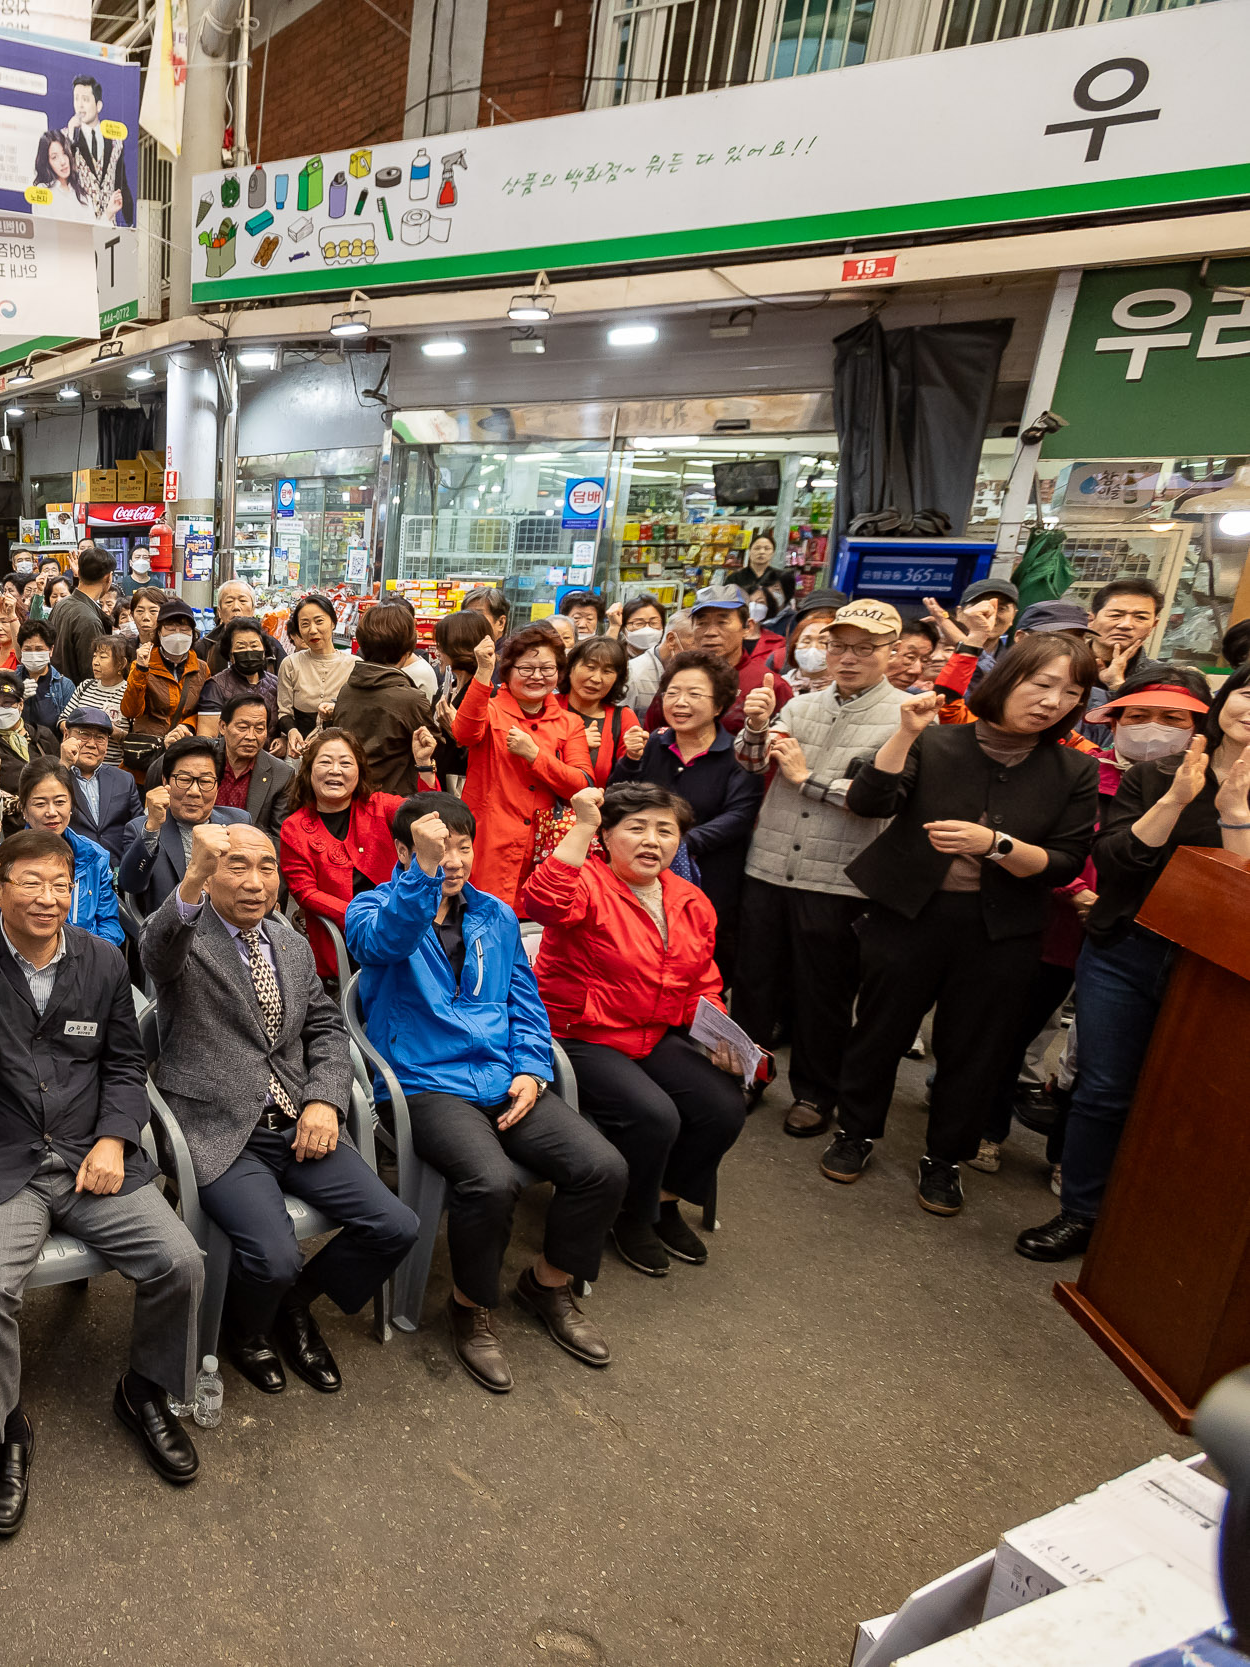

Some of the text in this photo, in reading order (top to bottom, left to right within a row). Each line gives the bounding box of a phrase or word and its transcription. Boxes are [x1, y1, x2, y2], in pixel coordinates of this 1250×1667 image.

[1044, 57, 1161, 162] 우
[503, 173, 557, 195] 상품의
[856, 260, 877, 275] 15
[573, 491, 601, 504] 담배
[113, 506, 156, 520] Coca-Cola
[903, 568, 934, 582] 365
